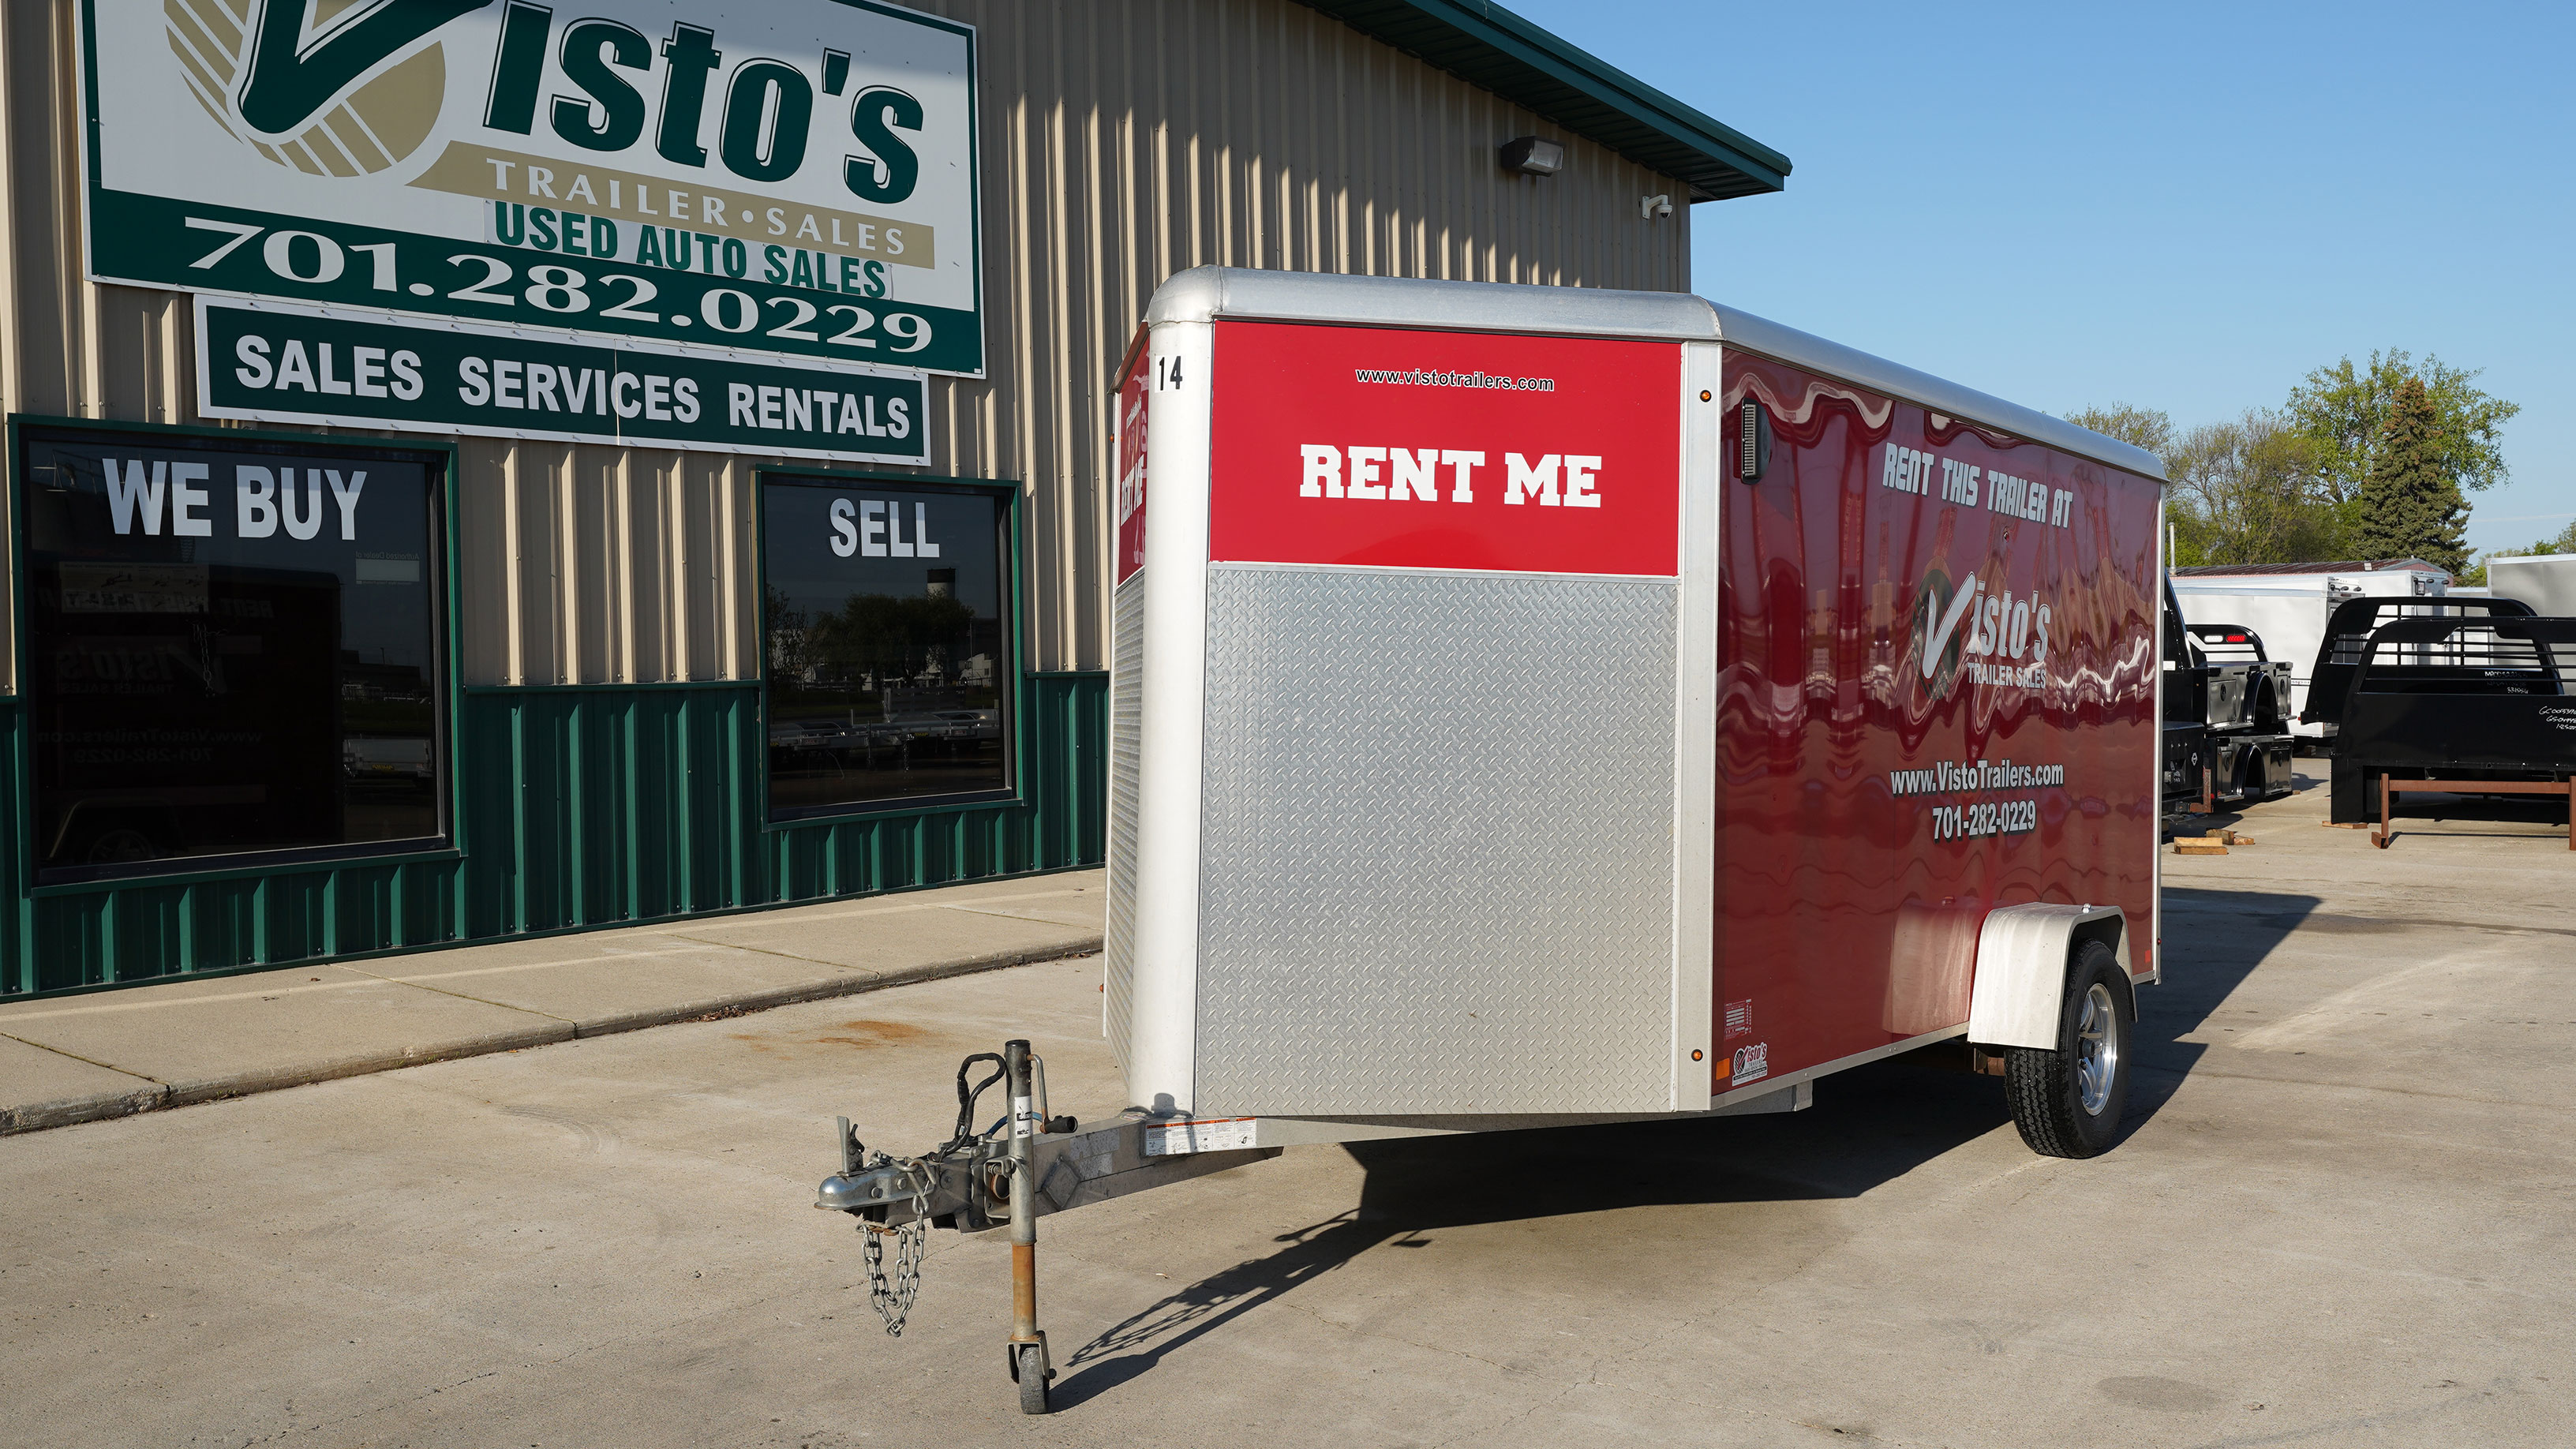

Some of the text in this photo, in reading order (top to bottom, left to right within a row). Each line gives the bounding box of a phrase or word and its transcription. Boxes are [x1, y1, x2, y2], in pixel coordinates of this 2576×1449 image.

[237, 0, 923, 204] Visto's
[486, 158, 907, 254] TRAILER SALES
[185, 215, 932, 353] 701.282.0229
[494, 201, 886, 299] USED AUTO SALES
[235, 334, 909, 439] SALES SERVICES RENTALS
[1158, 356, 1183, 390] 14
[1355, 368, 1555, 392] www.vistotrailers.com
[103, 459, 368, 541] WE BUY
[1300, 444, 1602, 507] RENT ME
[1883, 443, 2073, 528] RENT THIS TRAILER AT
[829, 498, 940, 557] SELL
[1923, 571, 2050, 679] Visto's
[1968, 662, 2046, 689] TRAILER SALES
[1891, 758, 2065, 796] www.VistoTrailers.com
[1932, 800, 2037, 841] 701-282-0229
